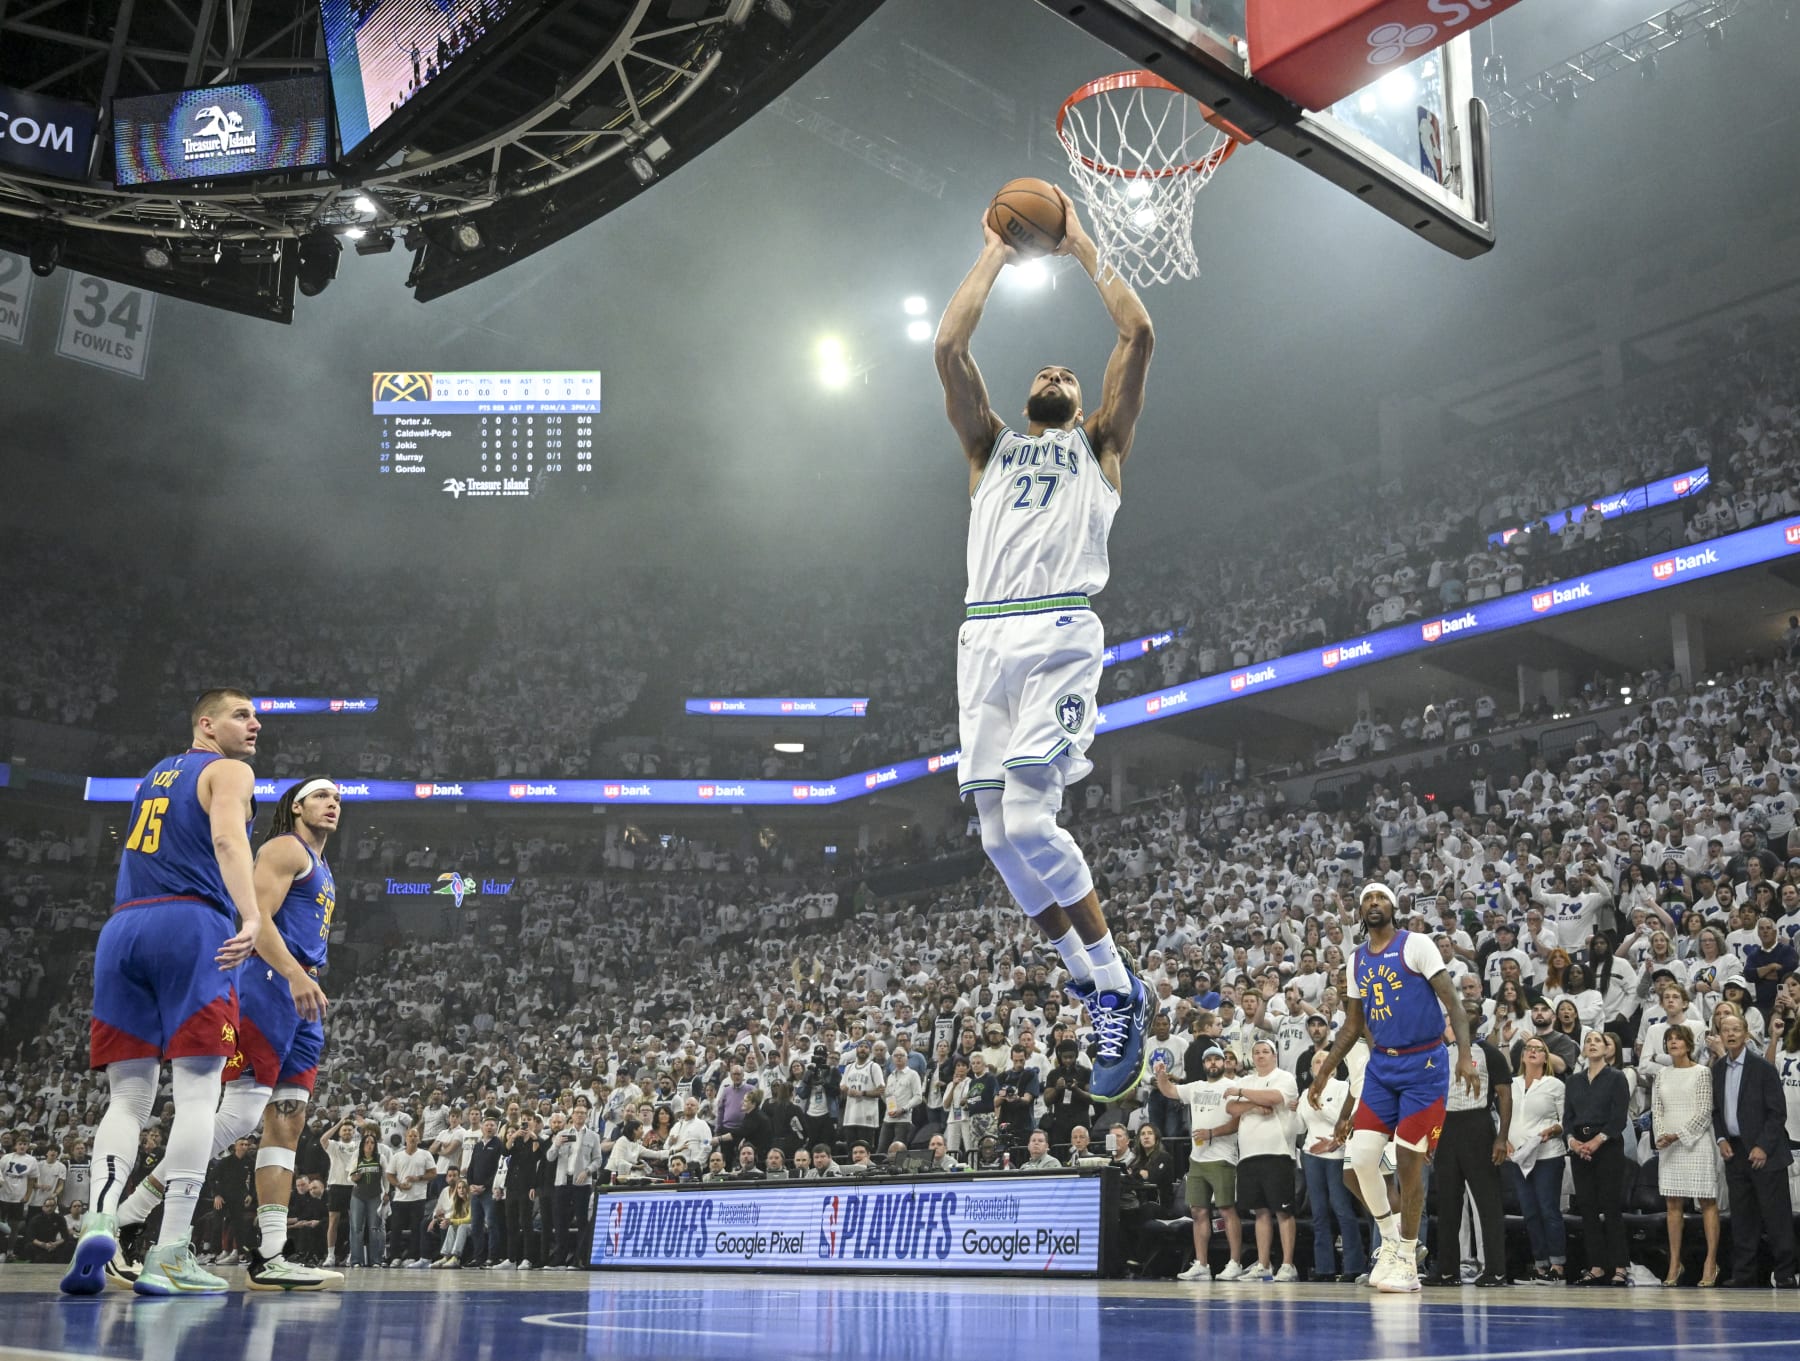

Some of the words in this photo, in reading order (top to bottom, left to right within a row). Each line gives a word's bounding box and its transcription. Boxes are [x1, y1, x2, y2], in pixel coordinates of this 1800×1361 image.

[183, 138, 222, 154] Treasure
[228, 131, 257, 148] Island
[73, 276, 143, 341] 34
[72, 329, 134, 361] FOWLES
[395, 418, 420, 426] Porter
[422, 418, 432, 426] Jr.
[482, 416, 488, 424] 0
[495, 416, 502, 424] 0
[512, 416, 518, 424] 0
[527, 416, 534, 424] 0
[546, 416, 562, 424] 0/0
[577, 416, 592, 424] 0/0
[395, 430, 452, 438] Caldwell-Pope
[482, 428, 488, 436] 0
[495, 428, 502, 436] 0
[512, 428, 518, 436] 0
[527, 428, 534, 436] 0
[546, 428, 562, 436] 0/0
[577, 428, 592, 436] 0/0
[395, 442, 418, 450] Jokic
[482, 440, 488, 448] 0
[495, 440, 502, 448] 0
[512, 440, 518, 448] 0
[527, 440, 534, 448] 0
[546, 440, 562, 448] 0/0
[577, 440, 592, 448] 0/0
[395, 453, 424, 462] Murray
[482, 452, 488, 460] 0
[495, 452, 502, 460] 0
[512, 452, 518, 460] 0
[527, 452, 534, 460] 0
[546, 452, 562, 460] 0/1
[577, 452, 592, 460] 0/0
[1001, 441, 1079, 476] WOLVES
[395, 465, 426, 473] Gordon
[482, 464, 488, 472] 0
[495, 464, 502, 472] 0
[512, 464, 518, 472] 0
[527, 464, 534, 472] 0
[546, 464, 562, 472] 0/0
[577, 464, 592, 472] 0/0
[466, 477, 502, 490] Treasure
[503, 477, 531, 490] Island
[1011, 473, 1060, 510] 27
[1653, 561, 1673, 575] us
[1675, 548, 1719, 571] bank
[1533, 593, 1552, 609] us
[1553, 582, 1592, 604] bank
[1423, 622, 1439, 637] us
[1441, 612, 1477, 634] bank
[1323, 649, 1340, 665] us
[1340, 641, 1374, 661] bank
[1230, 676, 1246, 690] us
[1246, 667, 1277, 686] bank
[273, 699, 296, 710] bank
[722, 701, 746, 710] bank
[793, 701, 816, 710] bank
[1146, 698, 1160, 712] us
[1161, 690, 1188, 708] bank
[876, 768, 898, 784] bank
[253, 784, 276, 795] ank
[340, 784, 370, 795] bank
[416, 785, 433, 795] us
[433, 784, 463, 796] bank
[511, 785, 526, 795] us
[527, 784, 557, 796] bank
[605, 785, 620, 796] us
[620, 785, 651, 796] bank
[700, 786, 714, 797] us
[715, 785, 745, 797] bank
[793, 786, 808, 798] us
[809, 785, 837, 797] bank
[125, 797, 170, 854] 15
[385, 878, 432, 894] Treasure
[1559, 903, 1570, 915] I
[1359, 967, 1376, 997] MILE
[1377, 964, 1403, 990] HIGH
[1372, 982, 1385, 1005] 5
[1370, 1004, 1392, 1020] CITY
[939, 1031, 945, 1039] 3
[1280, 1029, 1303, 1040] WOLVES
[1781, 1057, 1797, 1077] I
[718, 1201, 750, 1225] Presented
[751, 1202, 760, 1227] by
[963, 1195, 1006, 1221] Presented
[1007, 1194, 1020, 1224] by
[621, 1199, 713, 1259] PLAYOFFS
[839, 1191, 958, 1260] PLAYOFFS
[715, 1231, 766, 1259] Google
[769, 1230, 805, 1254] Pixel
[962, 1228, 1030, 1261] Google
[1035, 1228, 1080, 1255] Pixel
